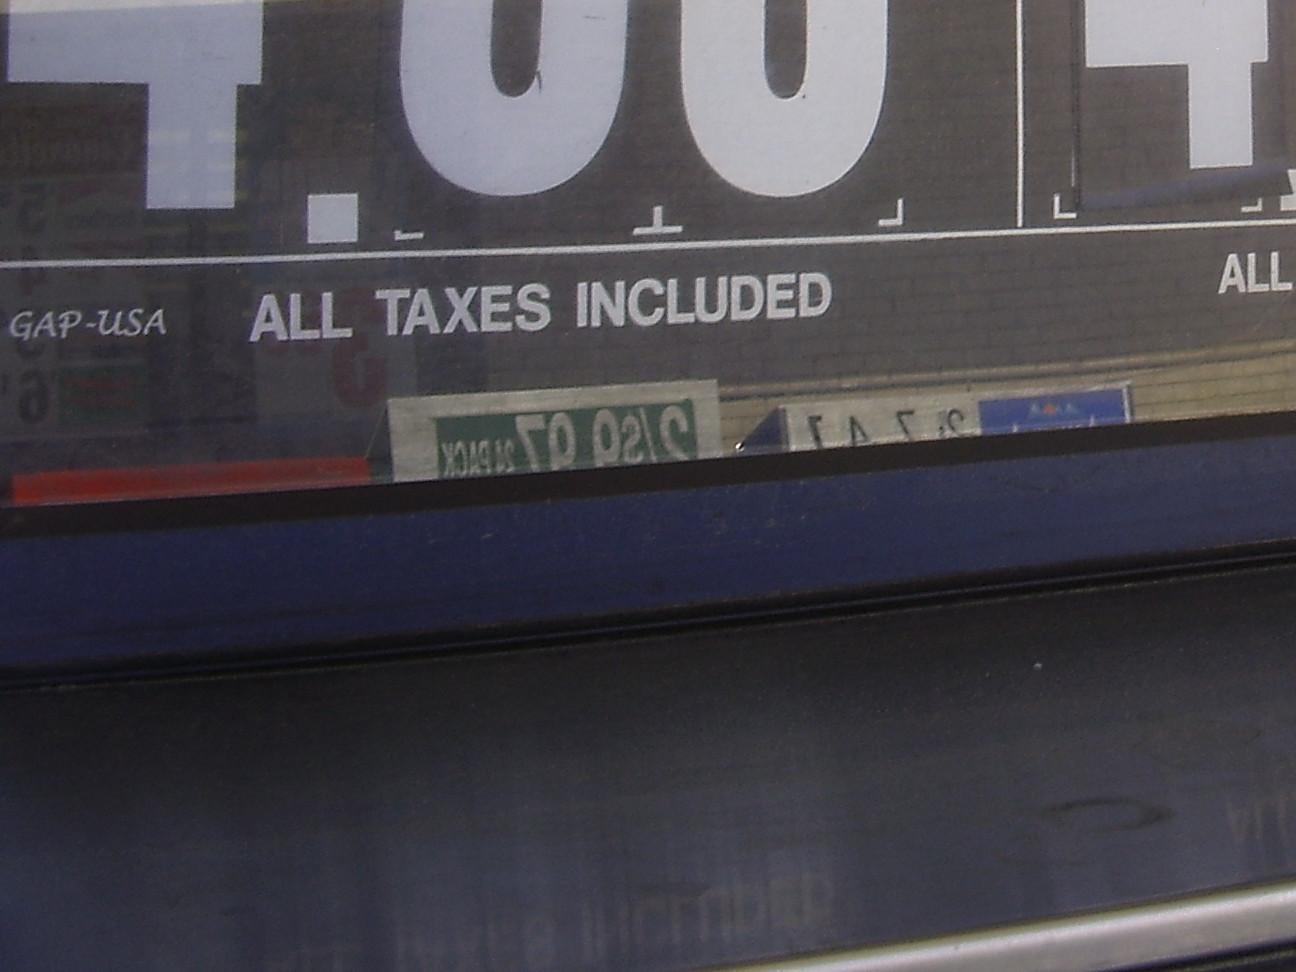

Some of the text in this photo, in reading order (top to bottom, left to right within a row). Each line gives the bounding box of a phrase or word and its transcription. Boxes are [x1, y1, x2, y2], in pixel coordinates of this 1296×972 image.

[1218, 252, 1292, 294] ALL
[9, 306, 167, 342] GAP-USA
[249, 272, 833, 342] ALL TAXES INCLUDED
